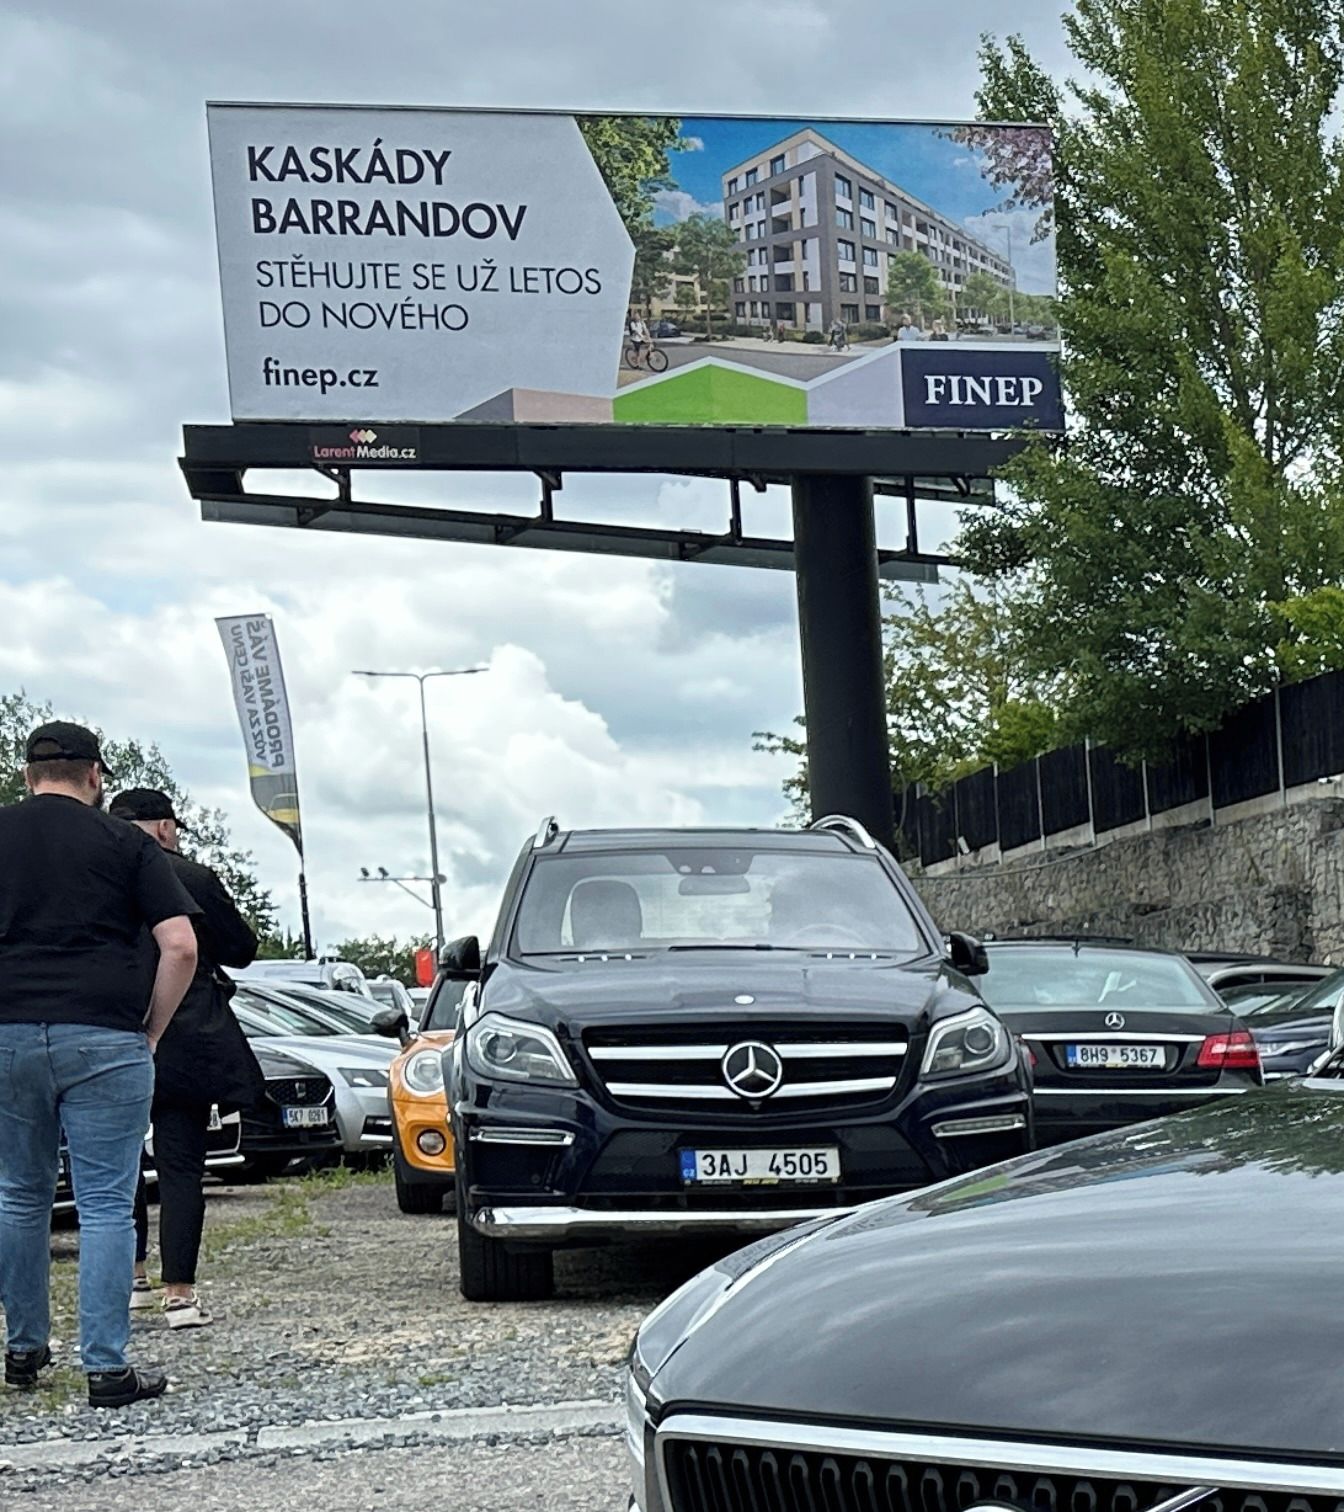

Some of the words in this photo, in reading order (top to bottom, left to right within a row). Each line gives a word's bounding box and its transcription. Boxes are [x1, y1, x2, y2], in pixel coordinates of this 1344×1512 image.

[247, 138, 452, 186] KASKÁDY
[251, 198, 527, 241] BARRANDOV
[256, 254, 402, 290] STĚHUJTE
[412, 264, 446, 290] SE
[458, 258, 500, 292] UŽ
[510, 266, 602, 295] LETOS
[259, 301, 311, 328] DO
[322, 296, 469, 331] NOVÉHO
[262, 357, 379, 395] finep.cz
[923, 375, 1043, 406] FINEP
[1080, 1047, 1109, 1062] 8H9
[1120, 1048, 1158, 1063] 5367
[702, 1154, 748, 1176] 3AJ
[768, 1152, 828, 1176] 4505
